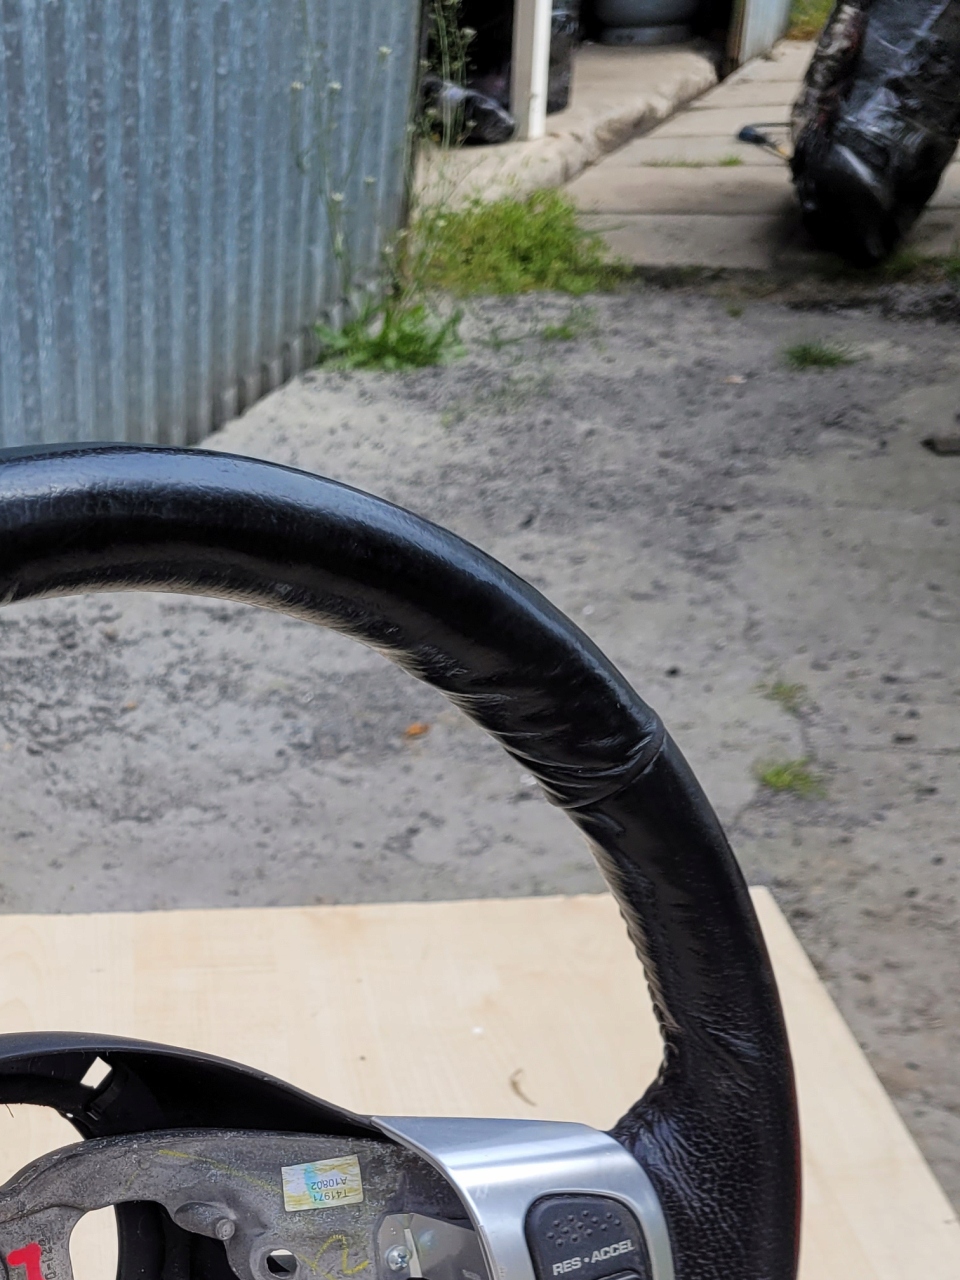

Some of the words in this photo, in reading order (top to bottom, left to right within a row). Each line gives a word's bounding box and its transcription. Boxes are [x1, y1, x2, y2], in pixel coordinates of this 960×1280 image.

[310, 1176, 348, 1191] A10802
[313, 1188, 350, 1203] T41971
[552, 1256, 582, 1276] RES
[590, 1239, 635, 1264] ACCEL
